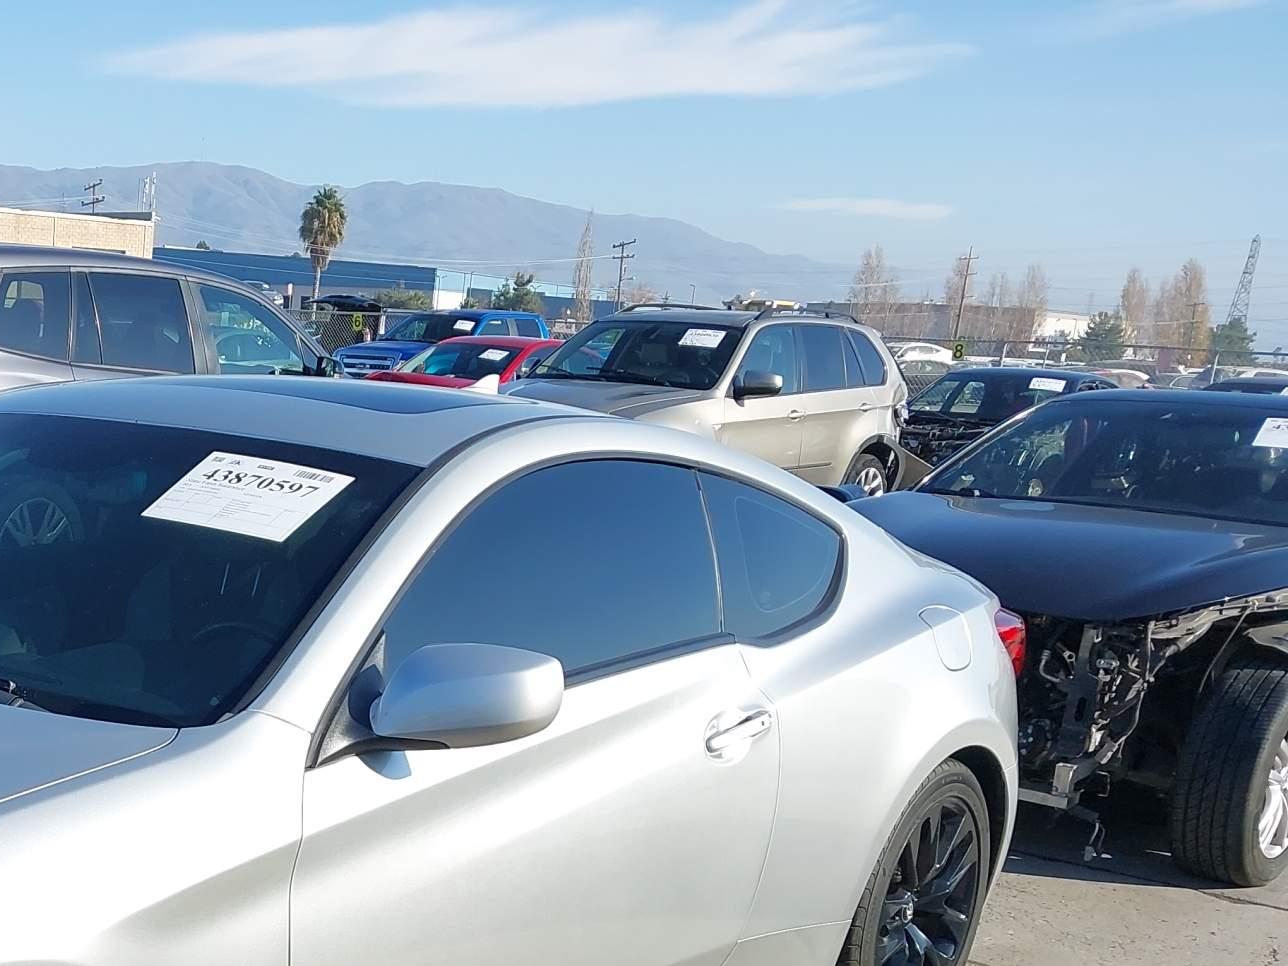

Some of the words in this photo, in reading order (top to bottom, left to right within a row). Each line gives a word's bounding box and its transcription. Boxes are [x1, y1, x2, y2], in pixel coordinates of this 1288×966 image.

[354, 315, 361, 328] 6
[953, 343, 964, 359] 8
[202, 468, 320, 498] 43870597
